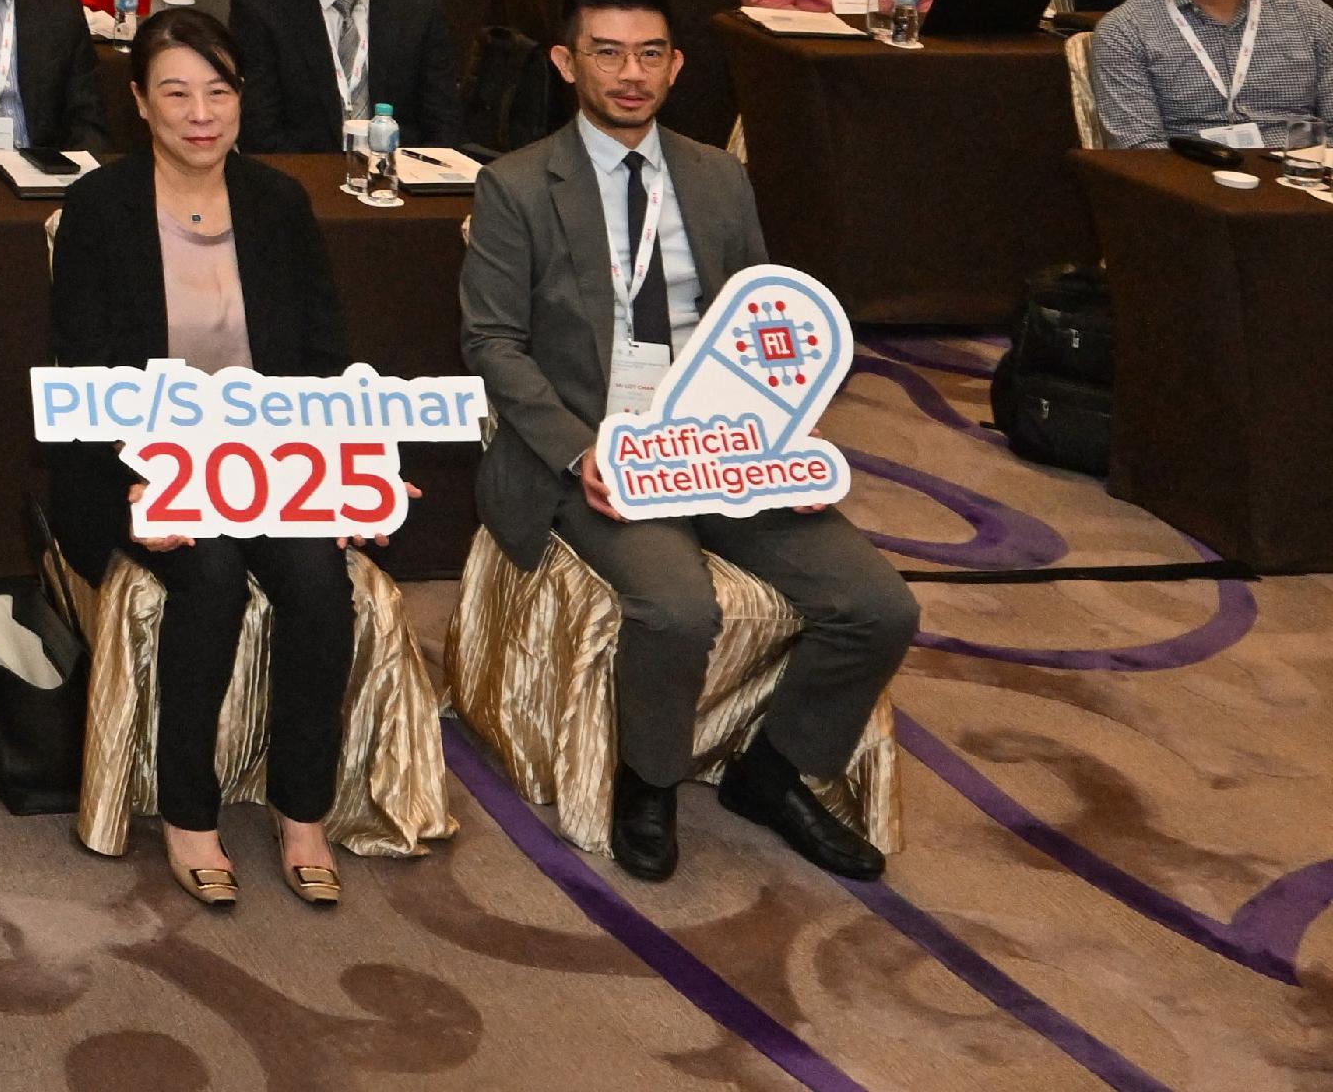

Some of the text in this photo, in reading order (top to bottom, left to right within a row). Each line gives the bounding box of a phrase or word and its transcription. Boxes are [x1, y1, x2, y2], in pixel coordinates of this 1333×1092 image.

[762, 331, 790, 355] AI
[43, 373, 475, 432] PIC/S Seminar
[619, 423, 760, 462] Artificial
[136, 441, 397, 525] 2025
[624, 459, 829, 495] Intelligence
